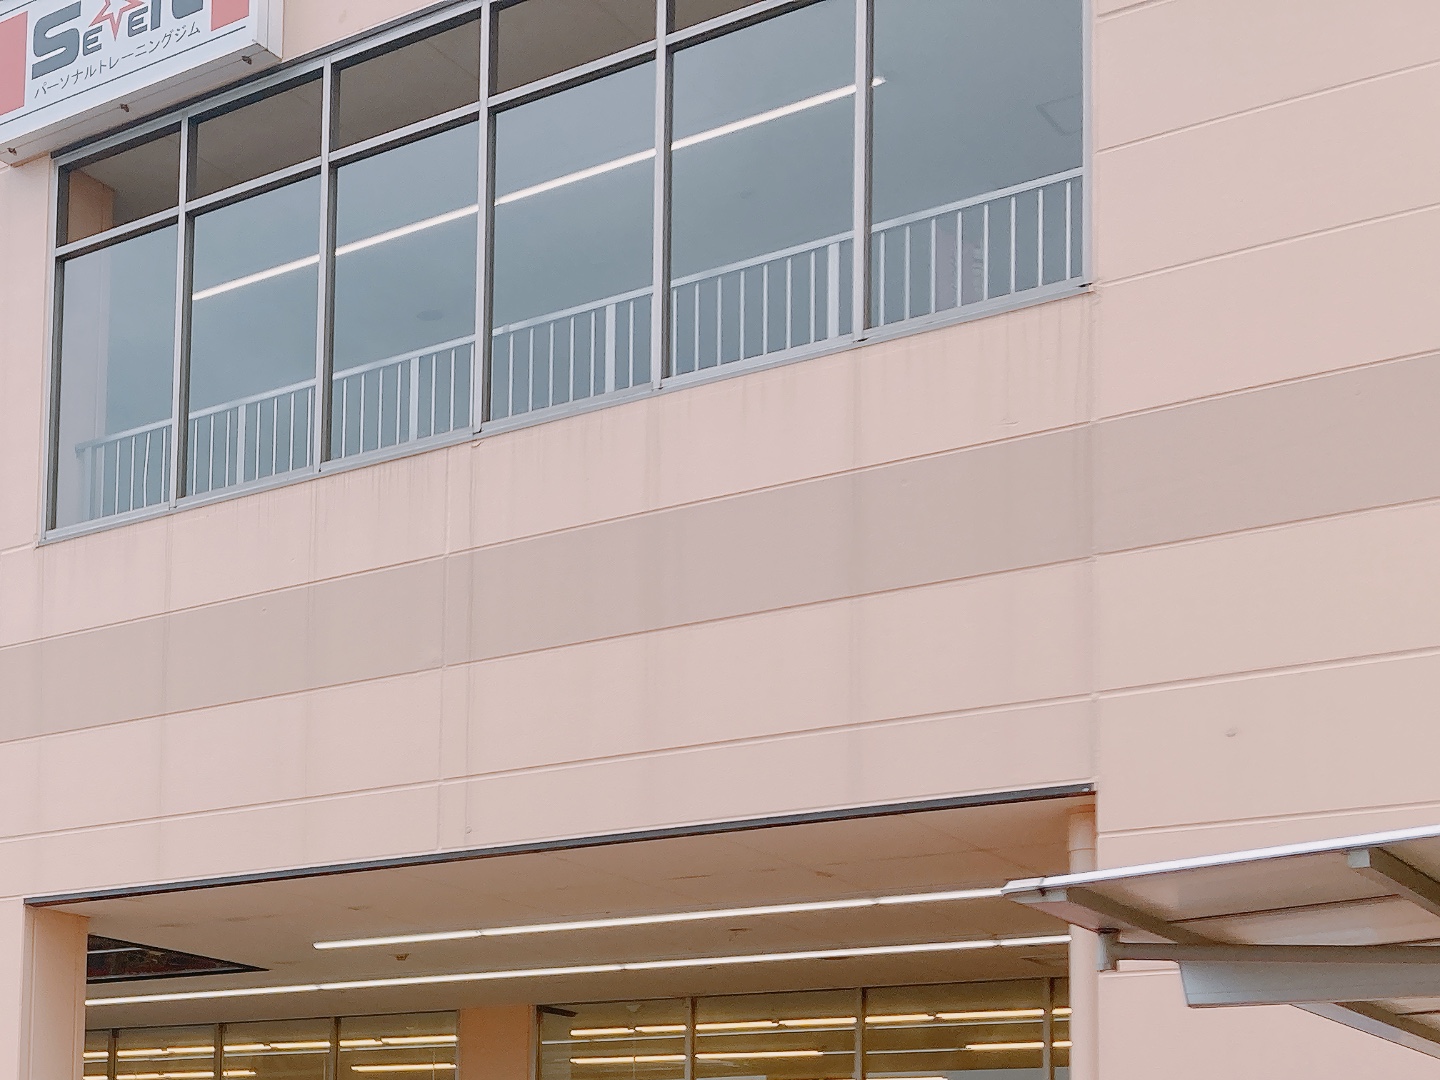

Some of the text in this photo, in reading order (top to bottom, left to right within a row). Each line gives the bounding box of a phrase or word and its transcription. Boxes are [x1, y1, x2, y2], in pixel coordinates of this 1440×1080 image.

[34, 21, 201, 99] パーソナルトレーニングジム
